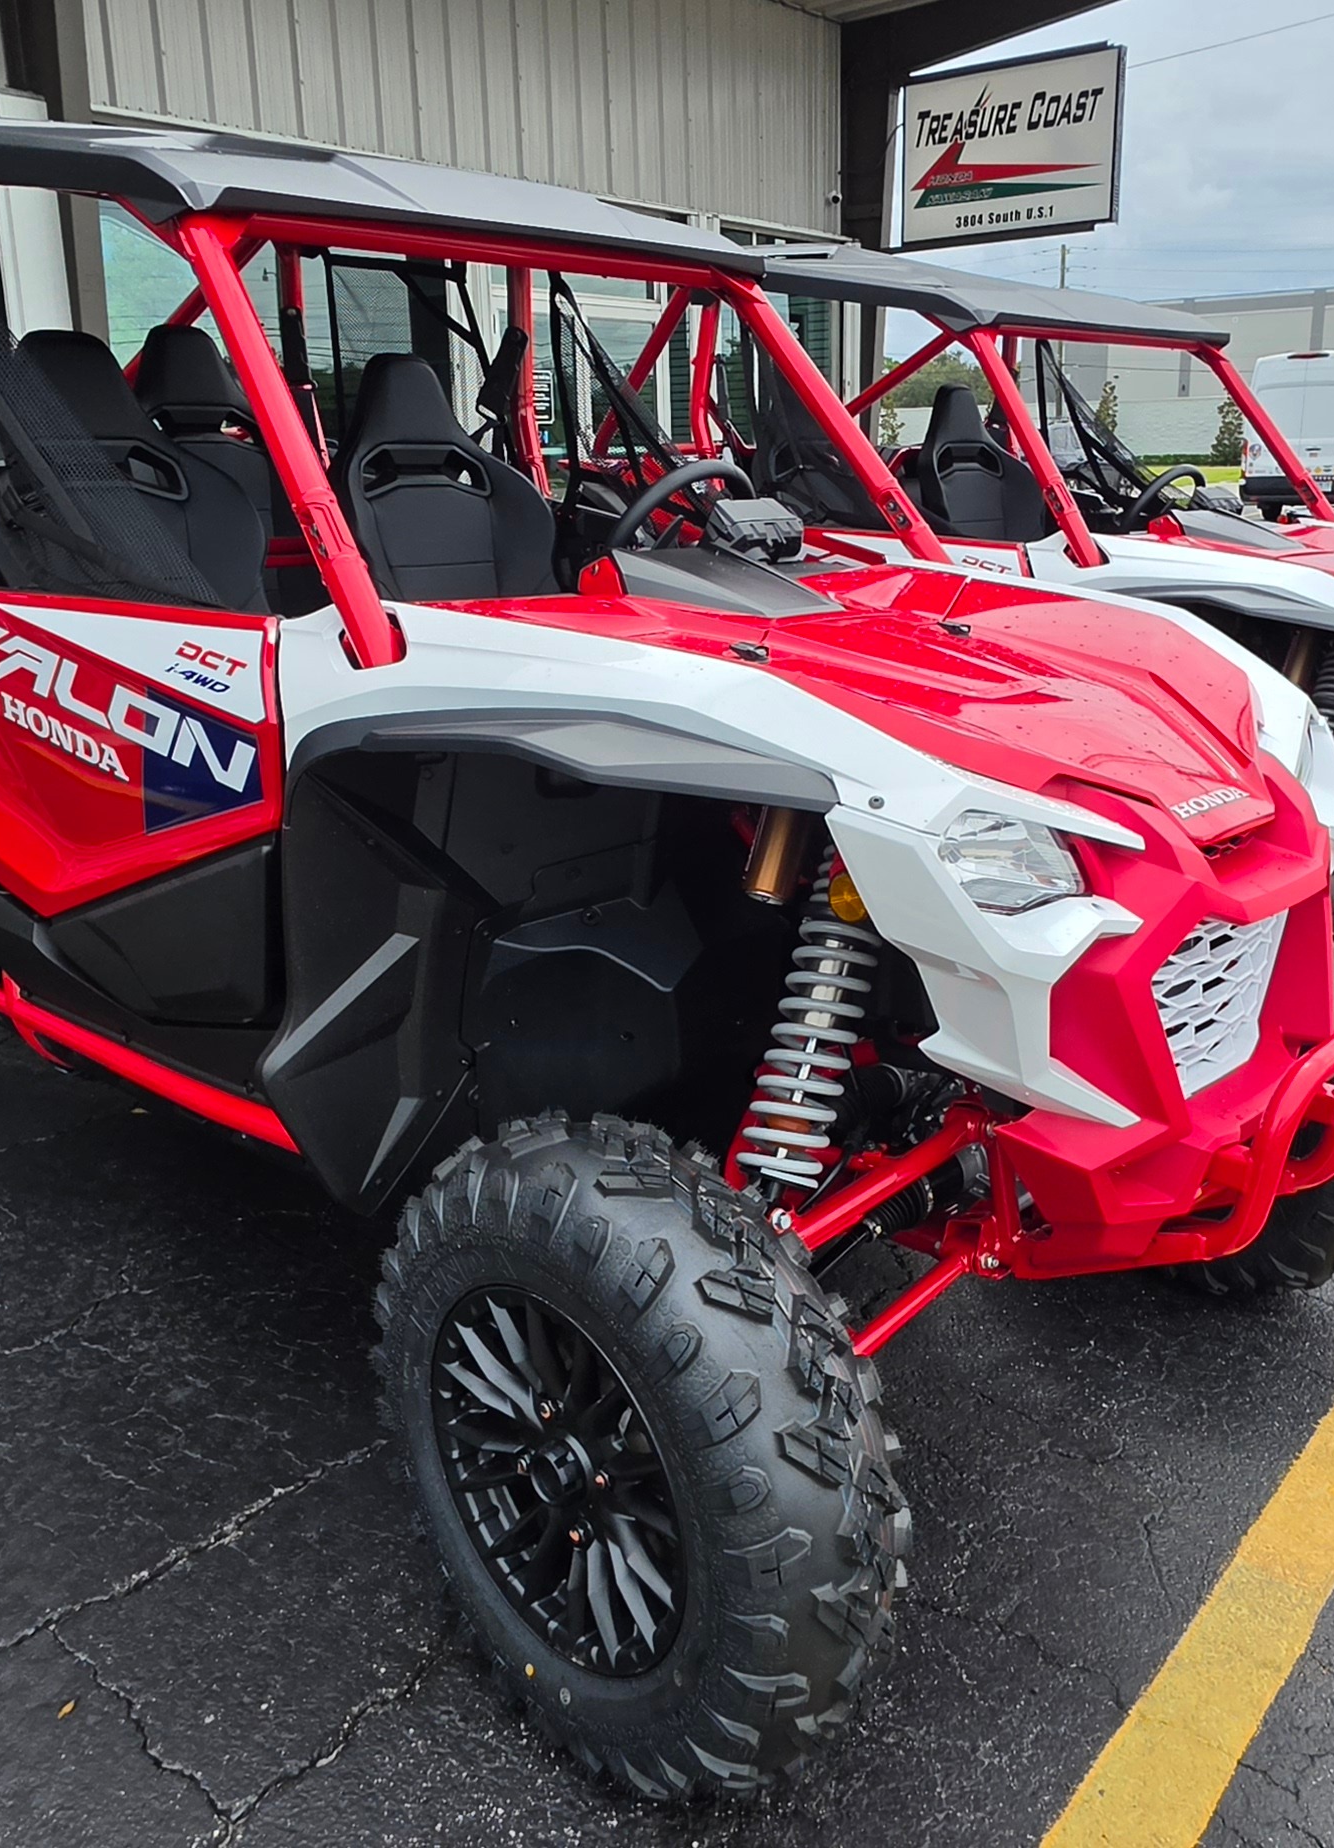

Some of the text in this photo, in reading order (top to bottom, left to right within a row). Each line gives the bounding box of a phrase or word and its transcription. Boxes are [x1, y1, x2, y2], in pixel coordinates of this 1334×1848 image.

[915, 87, 1105, 149] TREASURE COAST
[955, 214, 984, 229] 3804
[988, 209, 1021, 224] South
[175, 640, 248, 677] DCT
[165, 662, 231, 694] i-4WD
[0, 691, 130, 782] HONDA
[1170, 786, 1251, 819] HONDA
